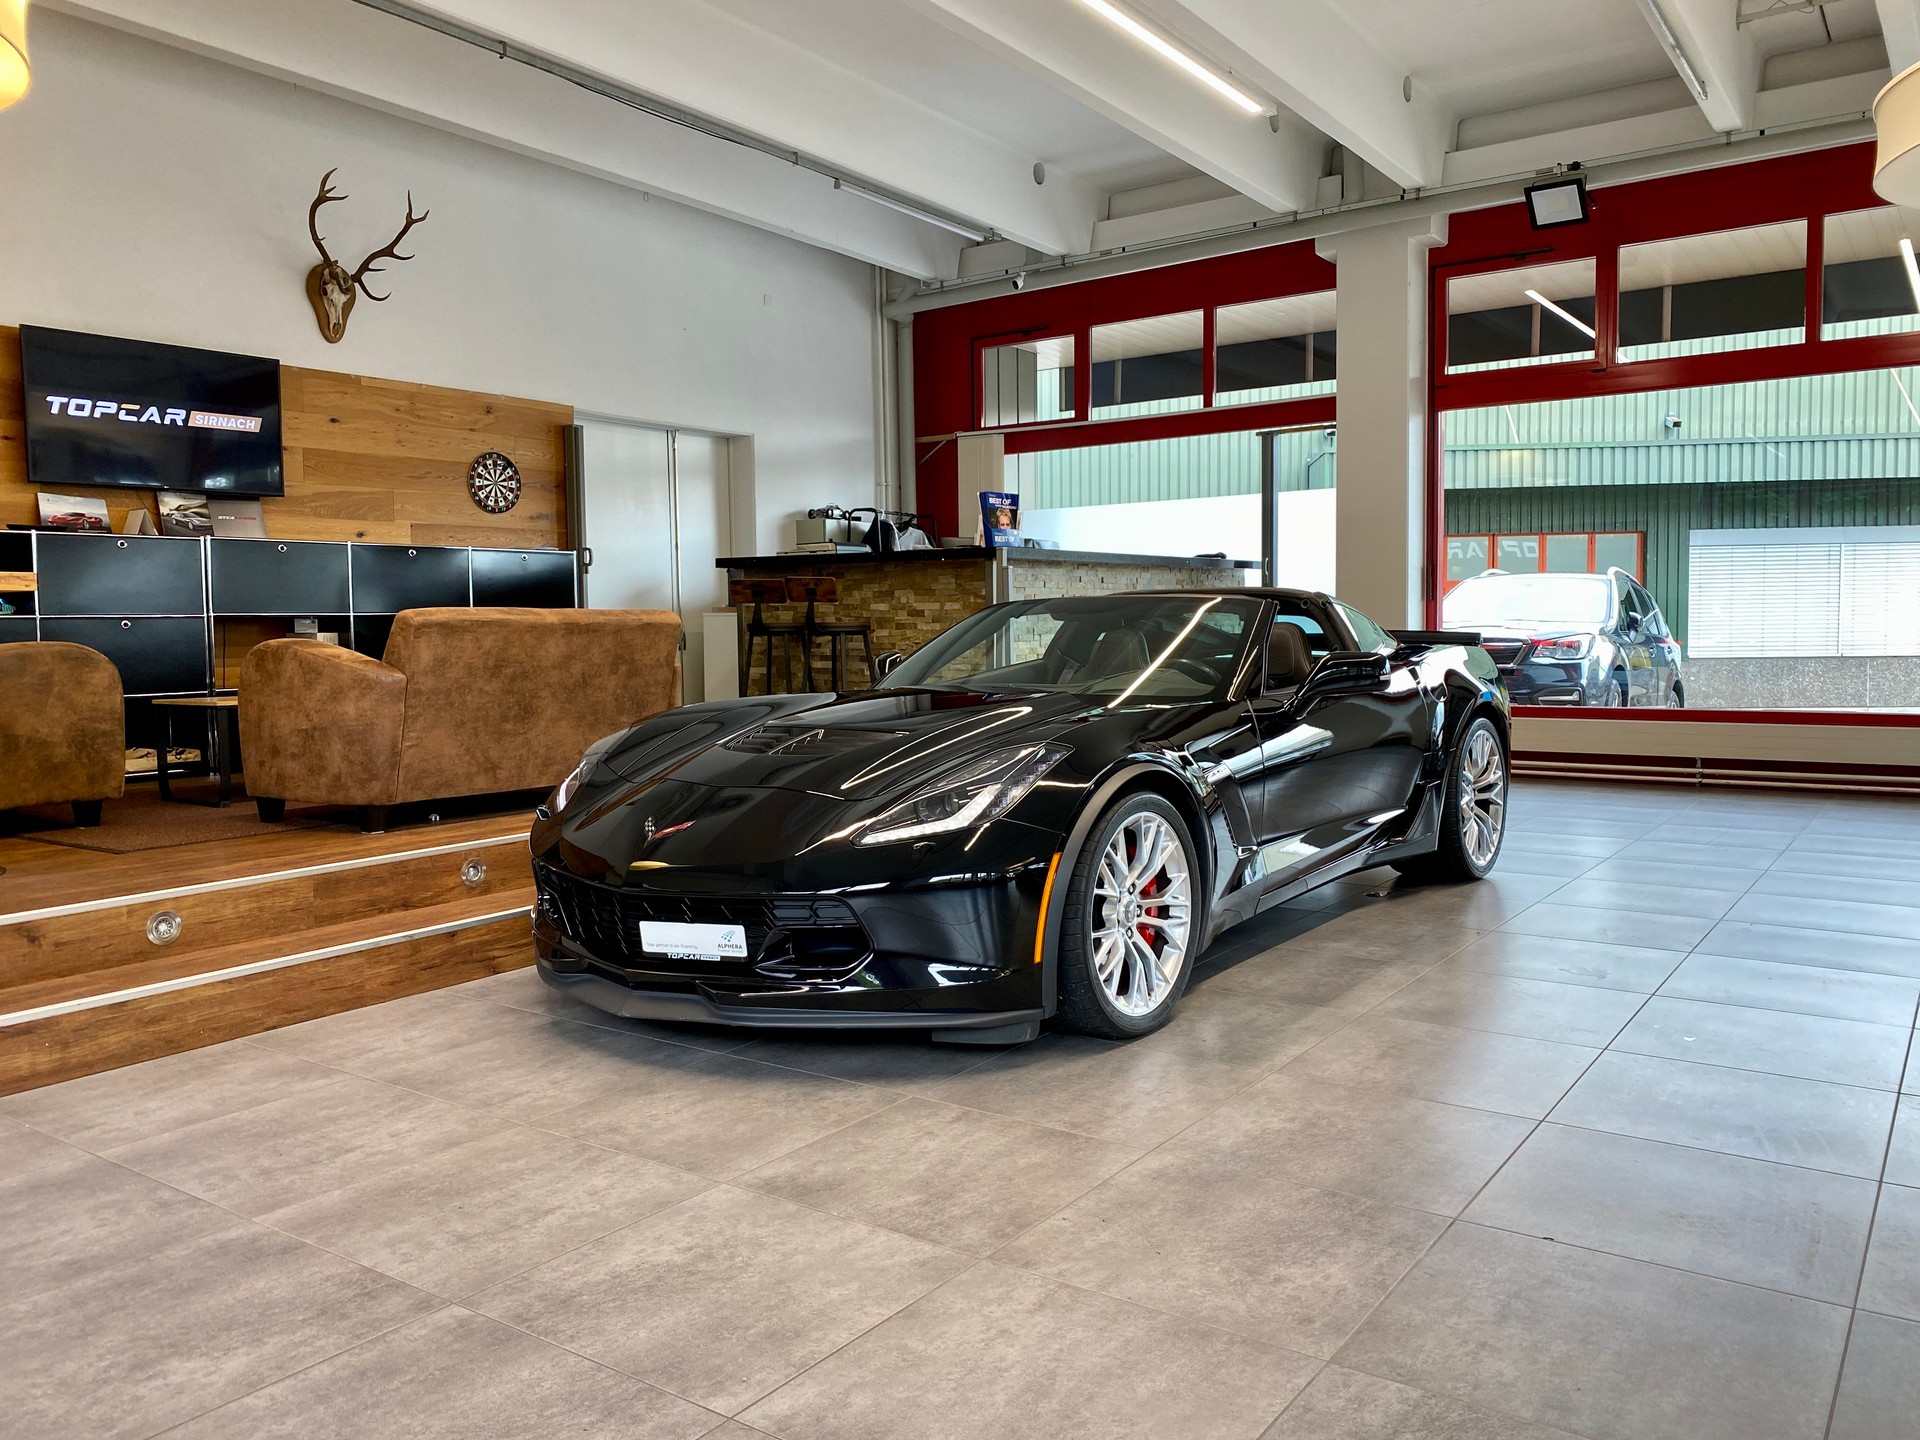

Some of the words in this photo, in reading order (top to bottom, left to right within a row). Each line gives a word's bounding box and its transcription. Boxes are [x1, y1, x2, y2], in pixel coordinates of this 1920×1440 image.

[46, 395, 187, 427] TOPCAR
[194, 413, 256, 430] SIRNACH
[988, 497, 1002, 505] BEST
[1002, 498, 1012, 506] OF
[994, 535, 1007, 543] BEST
[666, 952, 700, 960] TOPCAR
